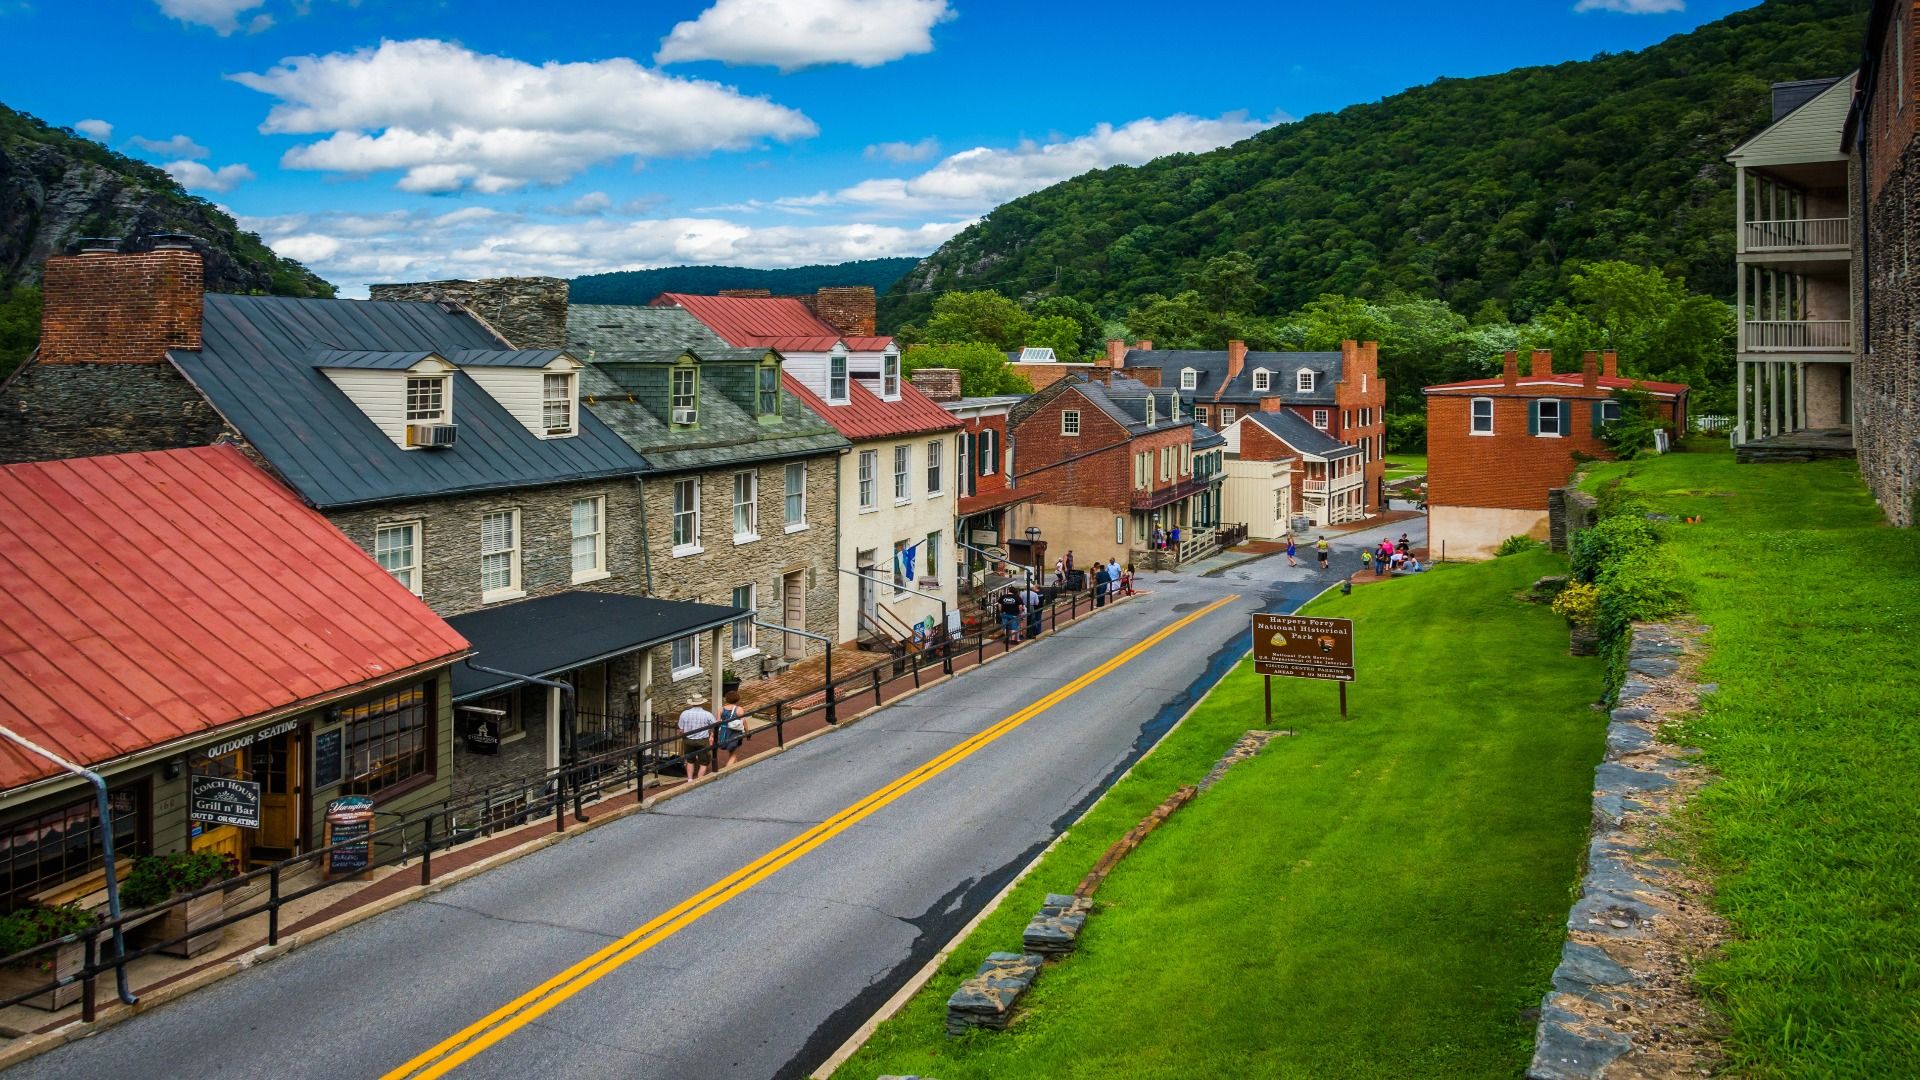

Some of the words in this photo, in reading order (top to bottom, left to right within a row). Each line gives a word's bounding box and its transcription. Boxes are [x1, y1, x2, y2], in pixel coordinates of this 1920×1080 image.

[1270, 617, 1306, 625] Harpers
[1258, 623, 1296, 631] National
[1300, 626, 1347, 634] Historical
[208, 734, 254, 758] OUTDOOR
[258, 719, 298, 741] SEATING
[193, 781, 225, 795] COACH
[228, 781, 257, 803] HOUSE
[196, 800, 221, 811] Grill
[236, 805, 254, 815] Bar
[329, 801, 373, 813] Yuengling
